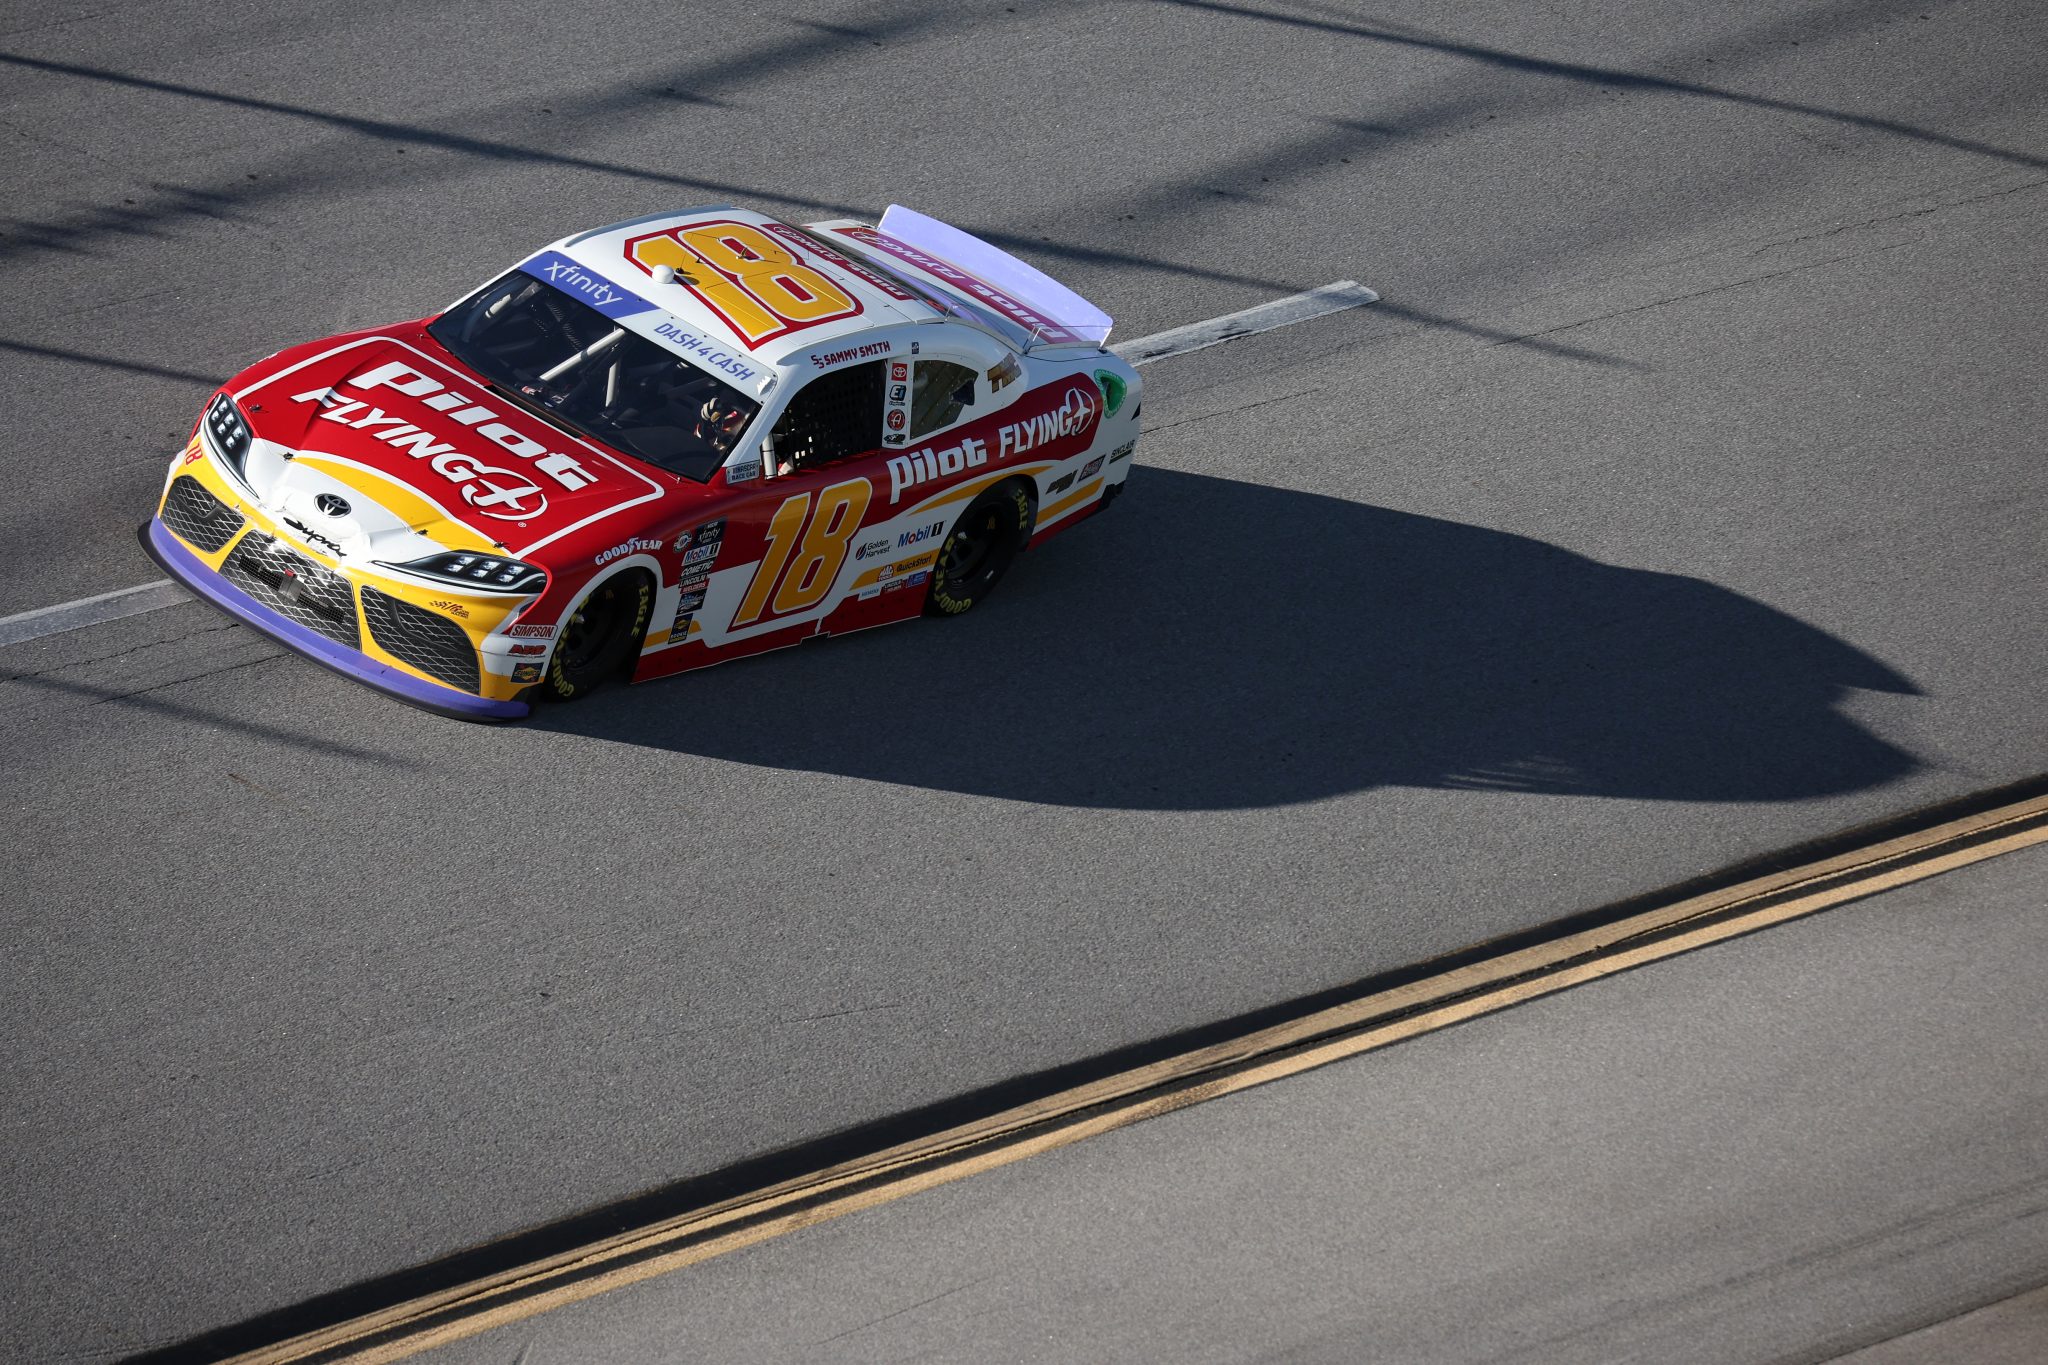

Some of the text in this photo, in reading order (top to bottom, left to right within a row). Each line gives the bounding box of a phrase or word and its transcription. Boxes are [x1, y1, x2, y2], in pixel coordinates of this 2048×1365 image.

[543, 260, 624, 306] xfinity
[625, 220, 864, 351] 18
[877, 238, 1070, 339] Pilot FLYING
[653, 322, 755, 382] DASH 4 CASH
[823, 347, 859, 366] SAMMY
[858, 340, 891, 358] SMITH
[290, 386, 478, 484] FLYING
[347, 360, 599, 492] Pilot
[886, 437, 988, 505] Pilot
[997, 404, 1073, 460] FLYING
[282, 516, 348, 557] Supra
[594, 537, 663, 566] GOODYEAR
[684, 546, 709, 563] Mobil
[731, 476, 873, 633] 18
[866, 546, 891, 558] Harvest
[867, 539, 889, 550] Golden
[898, 525, 932, 548] Mobil
[680, 574, 706, 587] LINCOLN
[681, 561, 714, 577] COMETIC
[512, 625, 554, 638] SIMPSON
[631, 584, 649, 638] EAGLE
